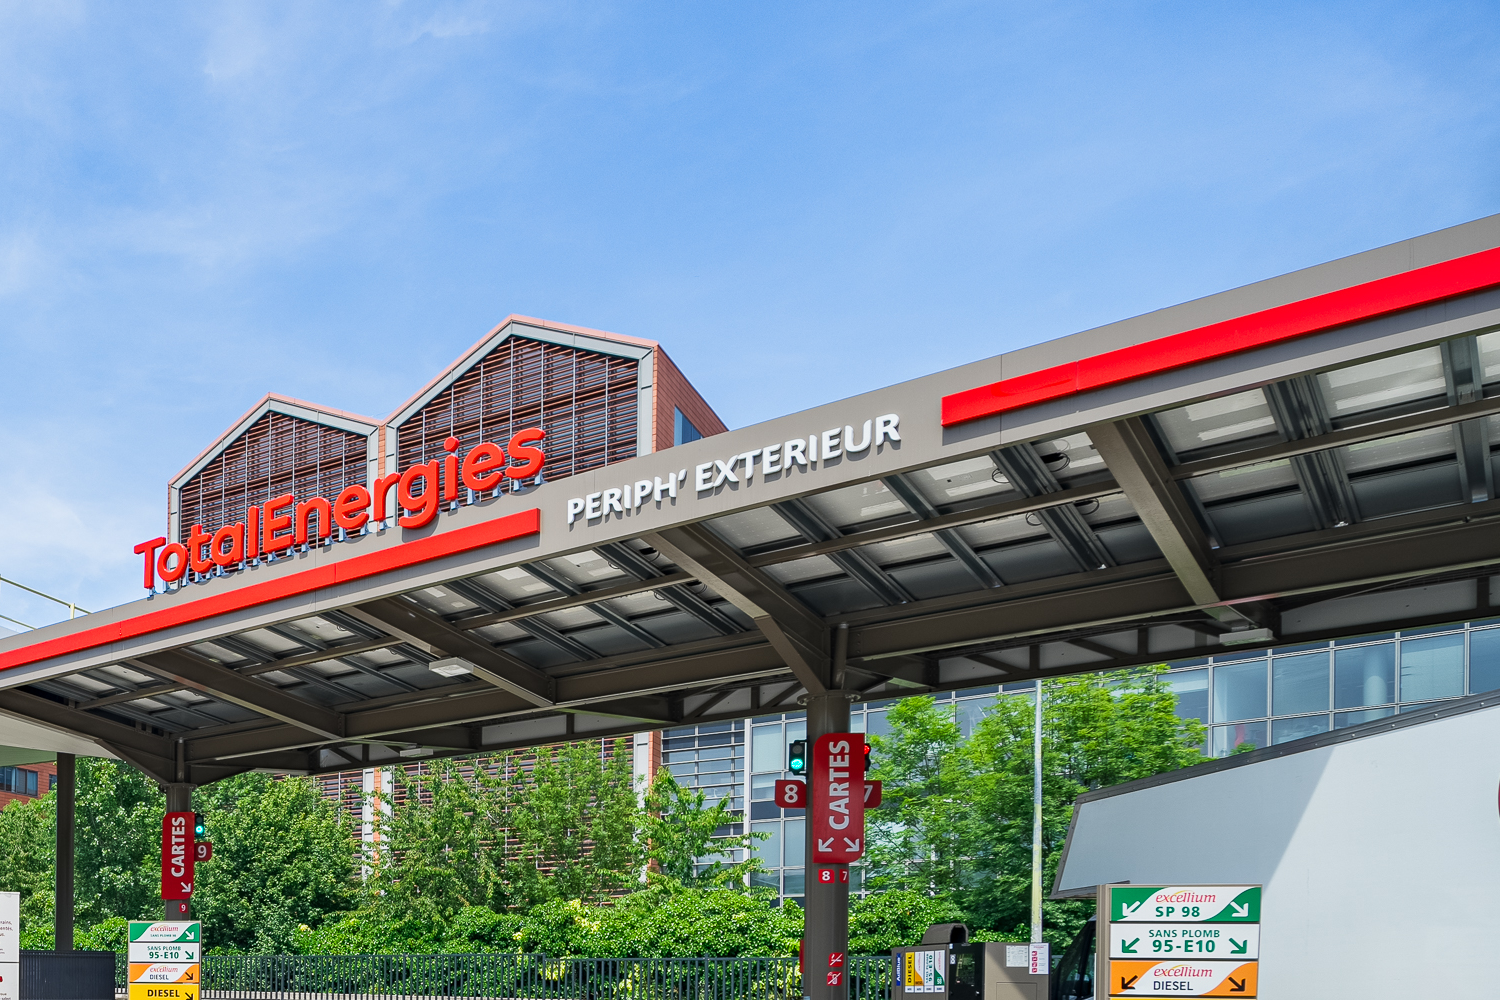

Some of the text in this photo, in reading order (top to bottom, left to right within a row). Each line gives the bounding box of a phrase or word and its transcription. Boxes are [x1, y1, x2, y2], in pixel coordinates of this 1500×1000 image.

[567, 413, 902, 524] PERIPH' EXTERIEUR
[133, 427, 546, 589] TotalEnergies
[828, 740, 850, 830] CARTES
[784, 784, 798, 803] 8
[864, 784, 873, 803] 7
[171, 816, 186, 877] CARTES
[197, 845, 207, 858] 9
[822, 871, 830, 881] 8
[842, 871, 847, 881] 7
[1155, 891, 1216, 903] excellium
[181, 904, 186, 912] 9
[1155, 906, 1200, 918] SP 98
[1148, 929, 1220, 938] SANS PLOMB
[1152, 939, 1216, 953] 95-E10
[149, 951, 179, 959] 95-E10
[1153, 965, 1213, 978] excellium
[1153, 981, 1194, 991] DIESEL
[147, 989, 180, 998] DIESEL
